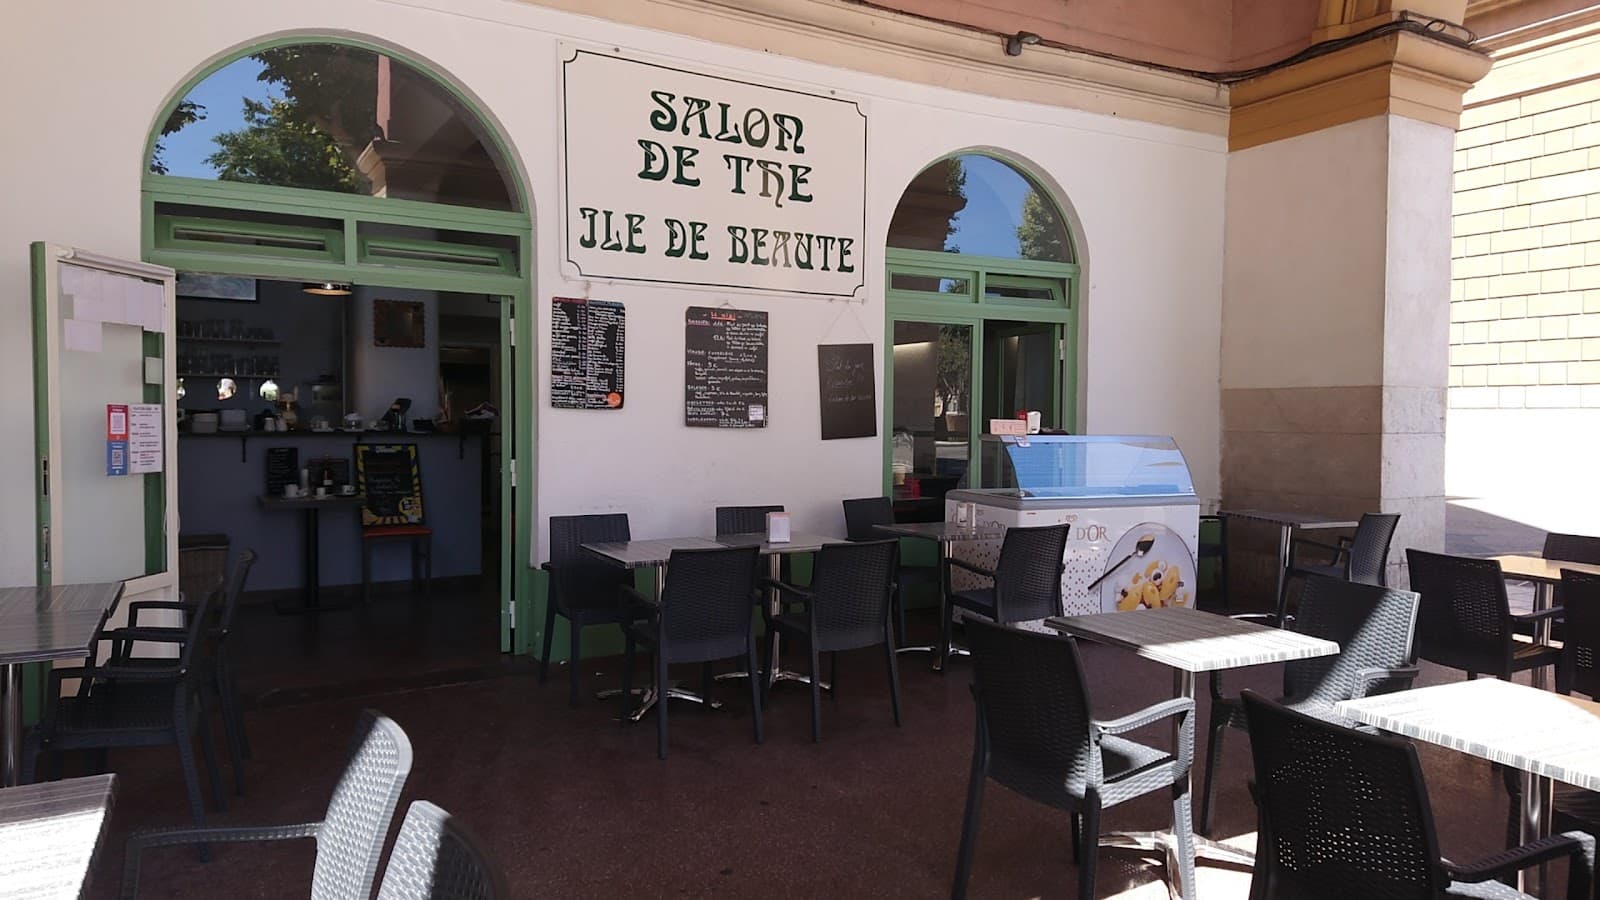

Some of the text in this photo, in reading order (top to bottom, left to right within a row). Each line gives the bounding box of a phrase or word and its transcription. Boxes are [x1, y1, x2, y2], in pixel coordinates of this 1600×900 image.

[650, 91, 805, 154] SALON
[637, 139, 813, 208] DE THE
[664, 218, 709, 260] DE
[727, 226, 854, 273] BEAUTE
[1076, 524, 1112, 542] D'OR
